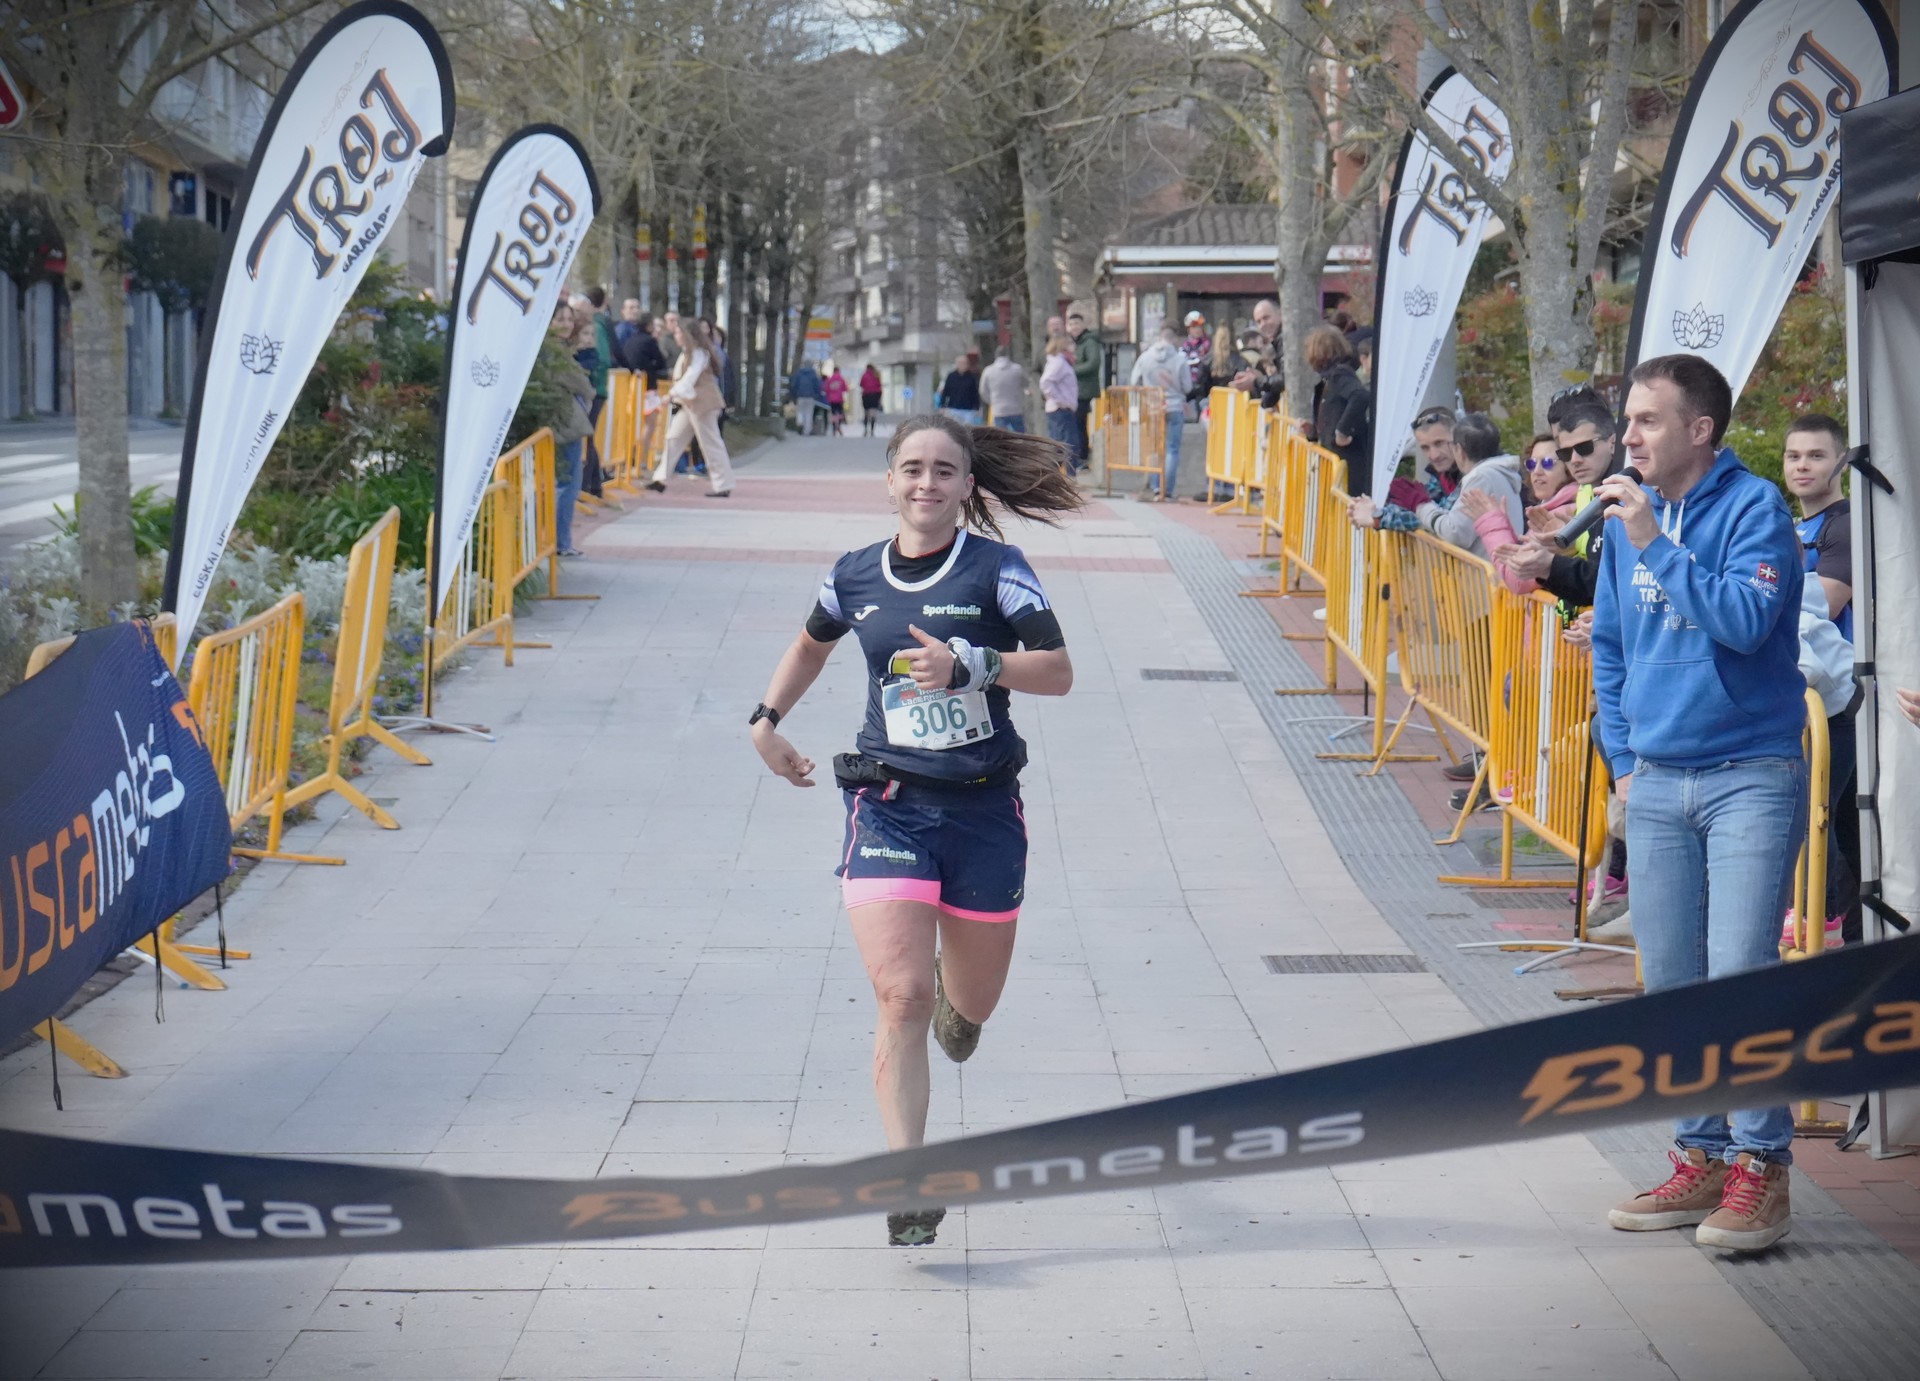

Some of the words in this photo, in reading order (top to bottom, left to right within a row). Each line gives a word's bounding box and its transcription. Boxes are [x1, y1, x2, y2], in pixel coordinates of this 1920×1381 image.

[246, 68, 422, 282] TROJ
[1671, 29, 1862, 260] TROJ
[466, 168, 577, 326] TROJ
[922, 604, 981, 617] Sportlandia
[909, 697, 967, 738] 306
[860, 845, 917, 861] Sportlandia
[559, 1111, 1365, 1230] Buscametas
